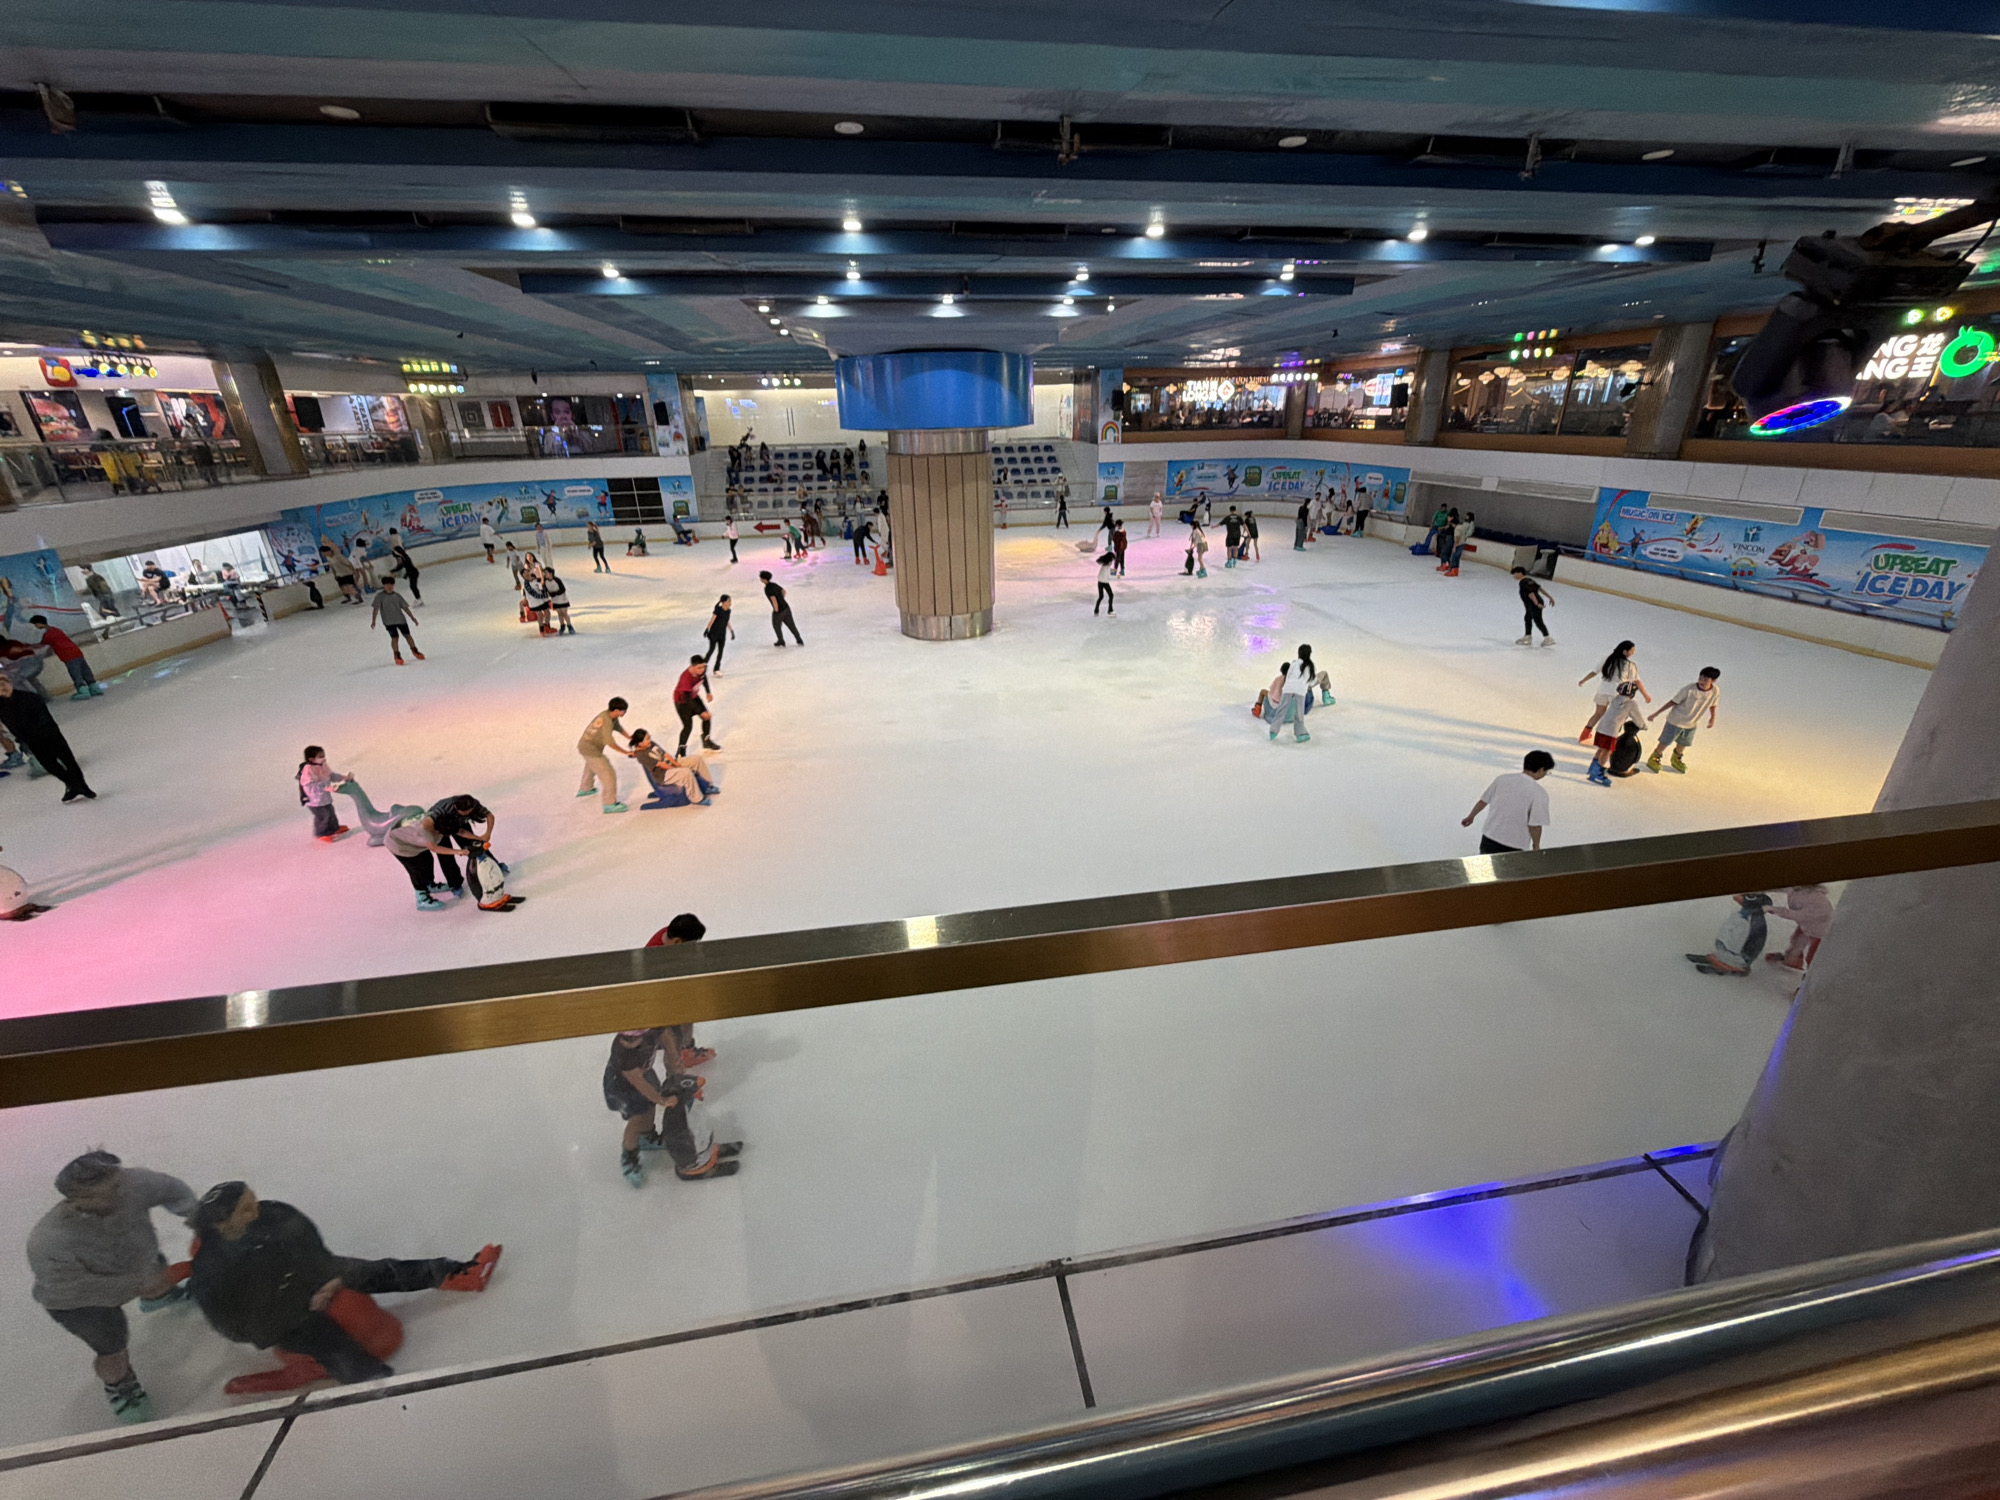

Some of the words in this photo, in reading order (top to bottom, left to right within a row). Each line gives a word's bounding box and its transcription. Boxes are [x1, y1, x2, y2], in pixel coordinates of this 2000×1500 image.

[1908, 356, 1937, 378] 王
[1182, 390, 1209, 402] LONG
[1621, 506, 1647, 519] MUSIC
[1647, 509, 1660, 520] ON
[1661, 512, 1676, 523] ICE
[1732, 542, 1765, 554] VINCOM
[1872, 553, 1958, 577] UPBEAT
[1854, 572, 1907, 598] ICE
[1908, 579, 1968, 601] DAY
